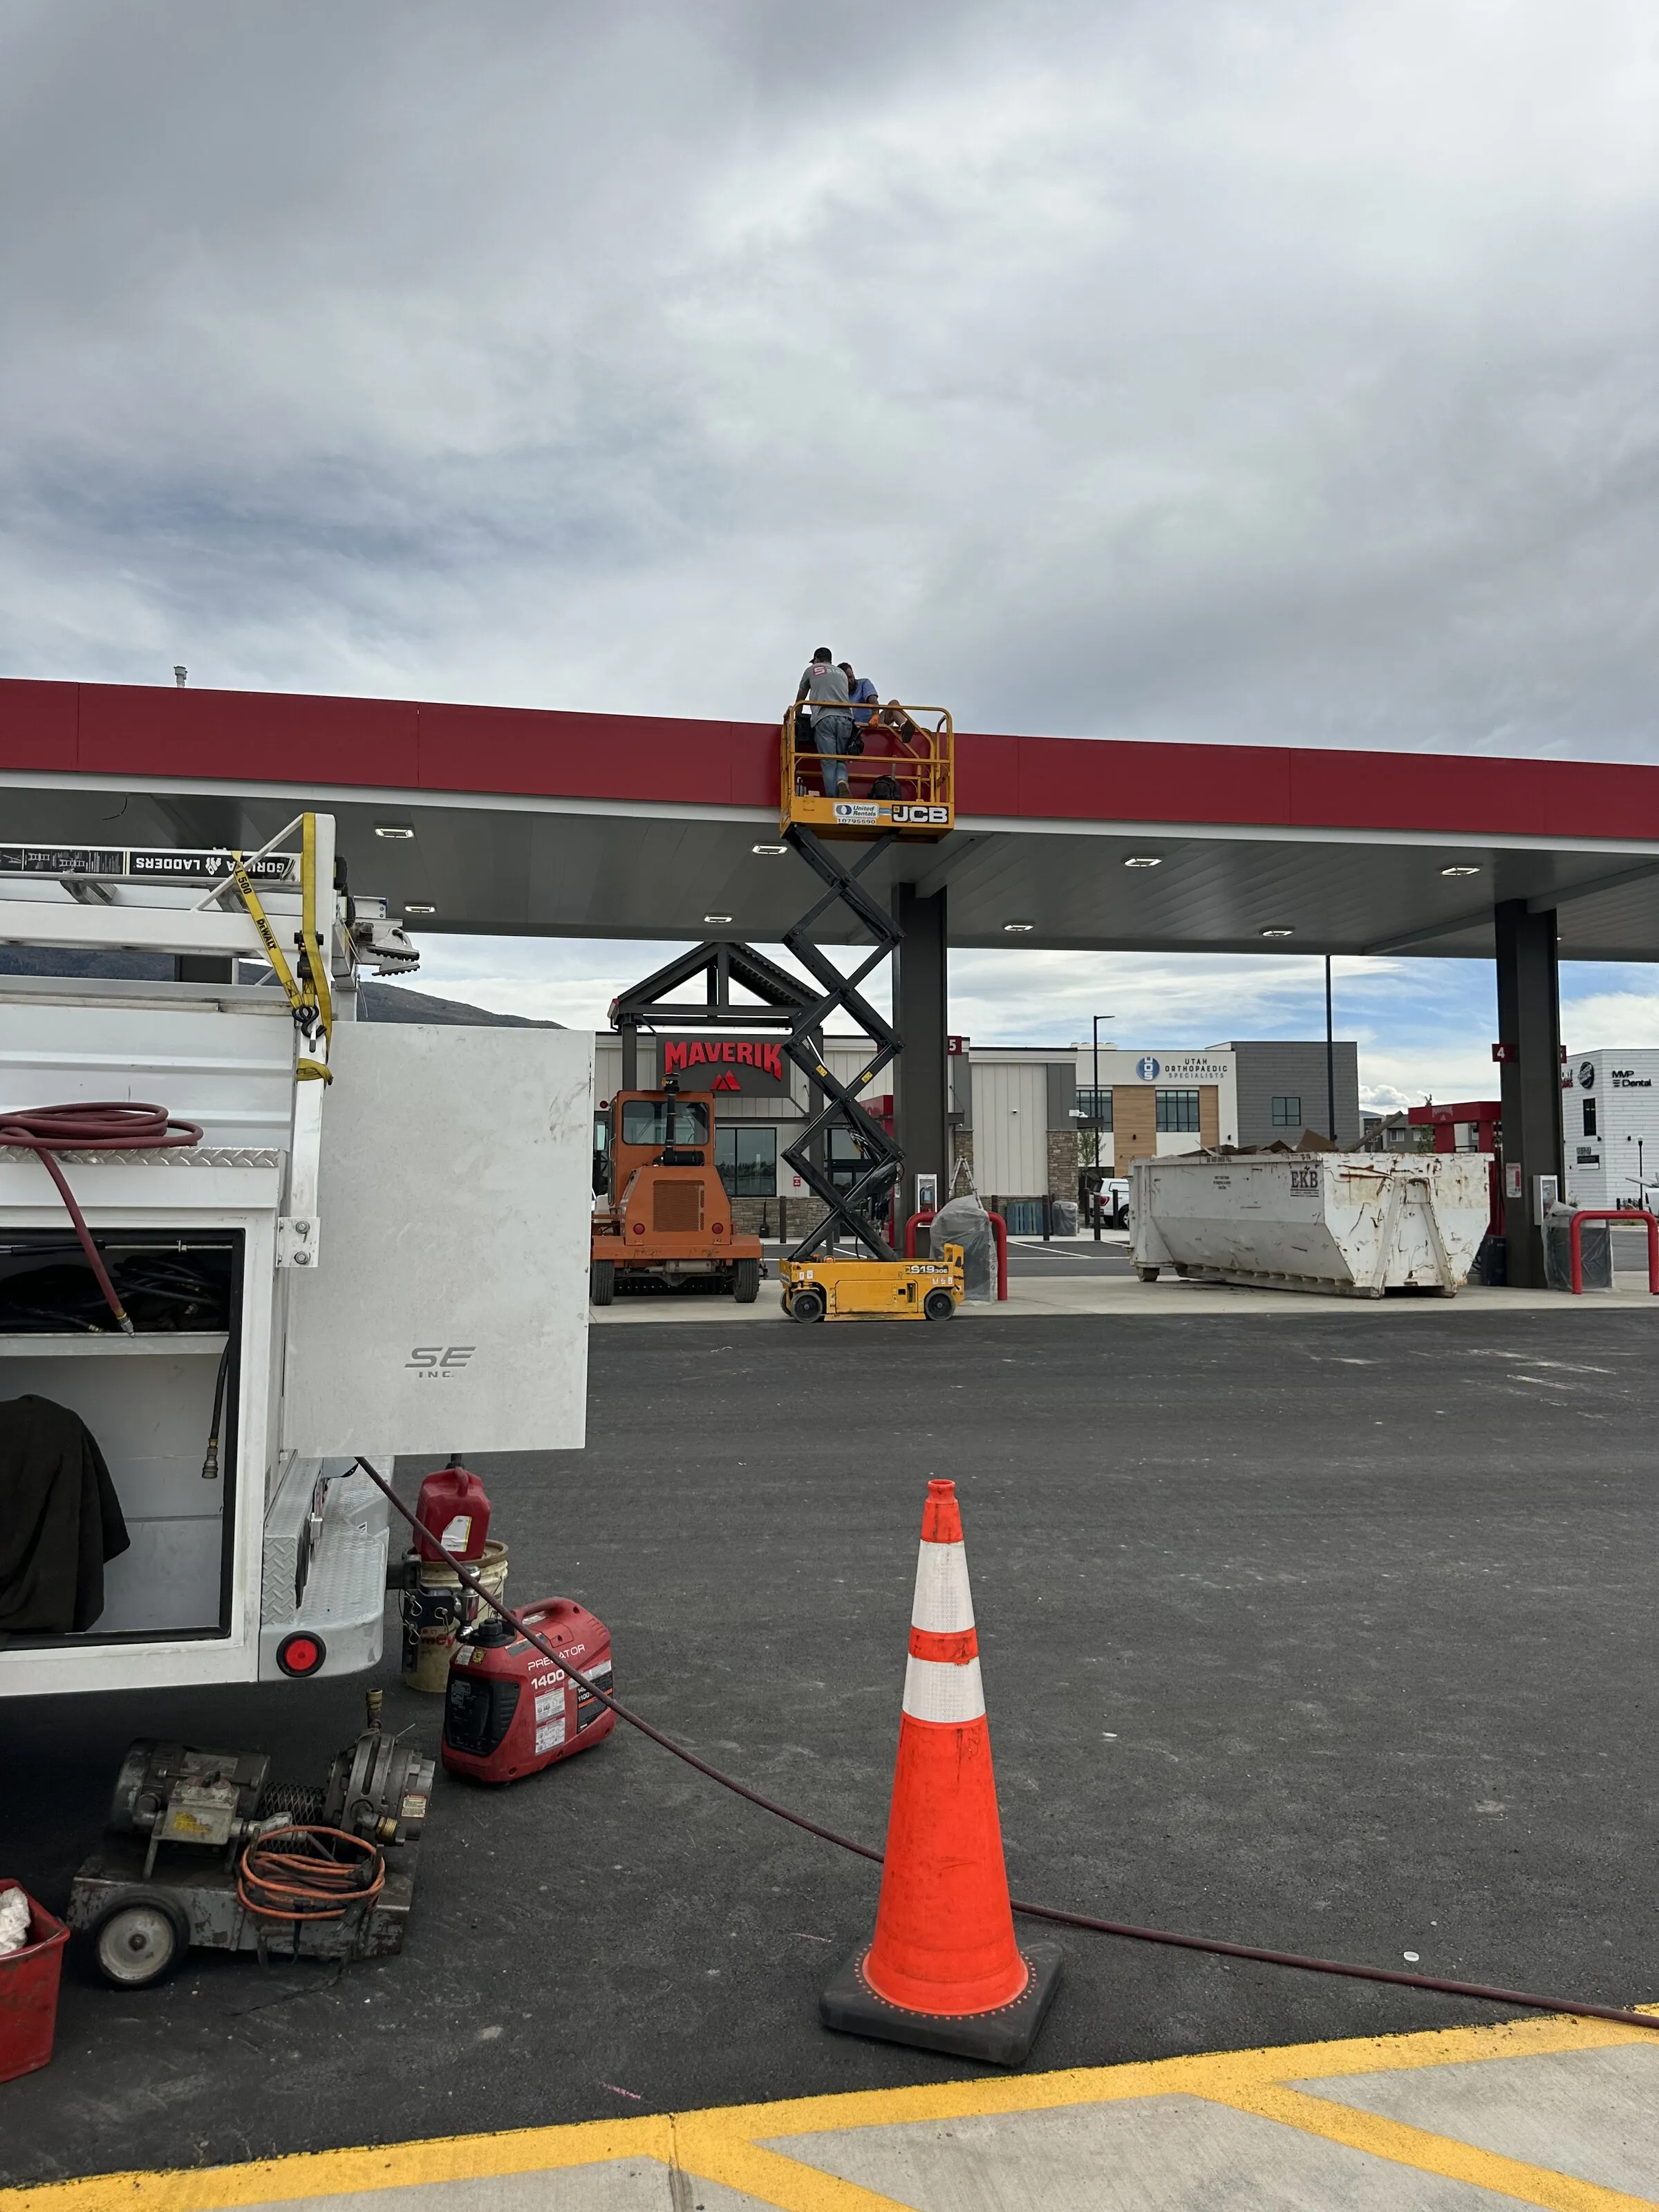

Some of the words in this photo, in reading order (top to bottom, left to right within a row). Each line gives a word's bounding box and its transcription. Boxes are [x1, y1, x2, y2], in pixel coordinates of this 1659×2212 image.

[893, 806, 948, 823] JCB
[135, 857, 200, 870] LADDERS
[226, 861, 285, 873] GORIA
[238, 874, 252, 894] 500
[948, 1039, 957, 1051] 5
[1497, 1047, 1506, 1058] 4
[664, 1041, 782, 1082] MAVERIK
[1291, 1171, 1318, 1188] EKB
[404, 1347, 477, 1367] SE
[527, 1644, 585, 1671] PREATOR
[531, 1669, 565, 1689] 1400
